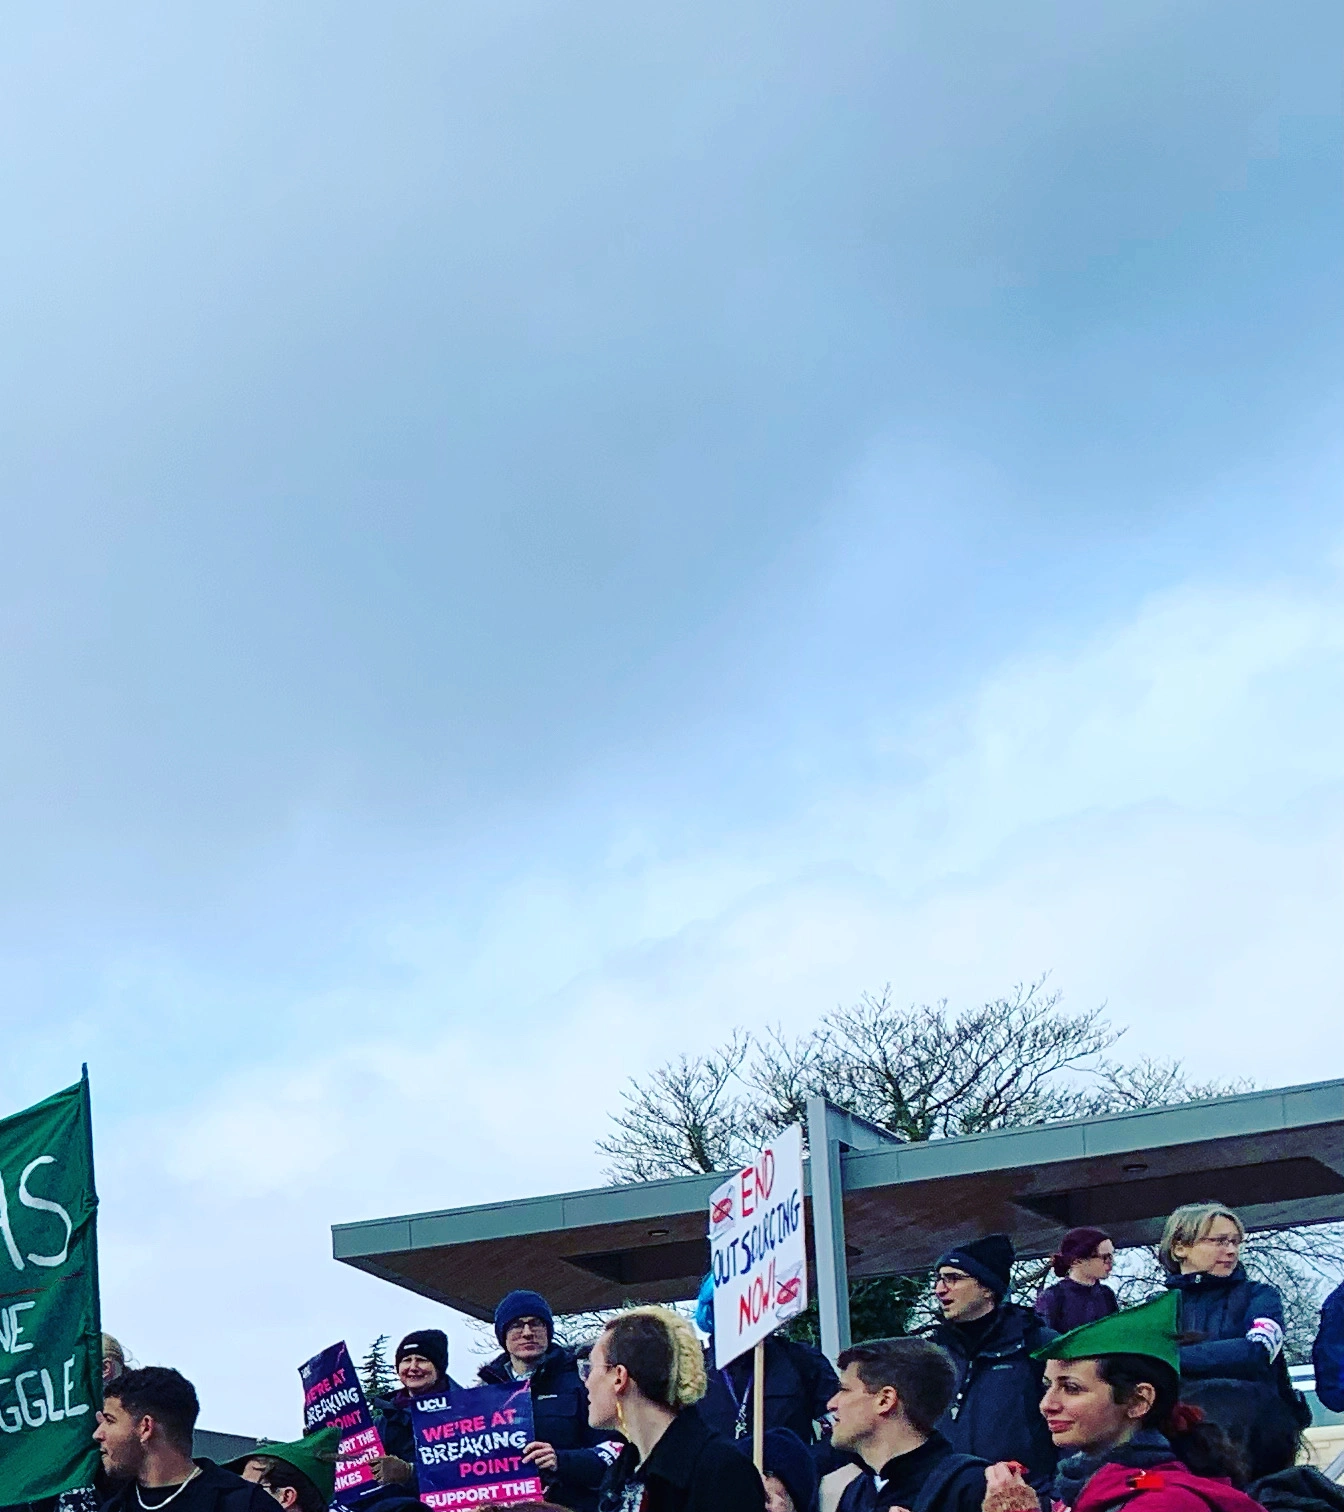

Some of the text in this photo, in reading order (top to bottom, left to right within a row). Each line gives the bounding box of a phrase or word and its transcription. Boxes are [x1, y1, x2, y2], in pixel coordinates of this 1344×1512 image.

[741, 1149, 774, 1217] END
[738, 1256, 776, 1336] NOW!
[416, 1397, 448, 1411] UCU
[422, 1409, 518, 1442] WE'RE AT
[418, 1431, 528, 1465] BREAKING
[459, 1456, 523, 1477] POINT
[425, 1486, 499, 1508] SUPPORT
[502, 1480, 537, 1497] THE
